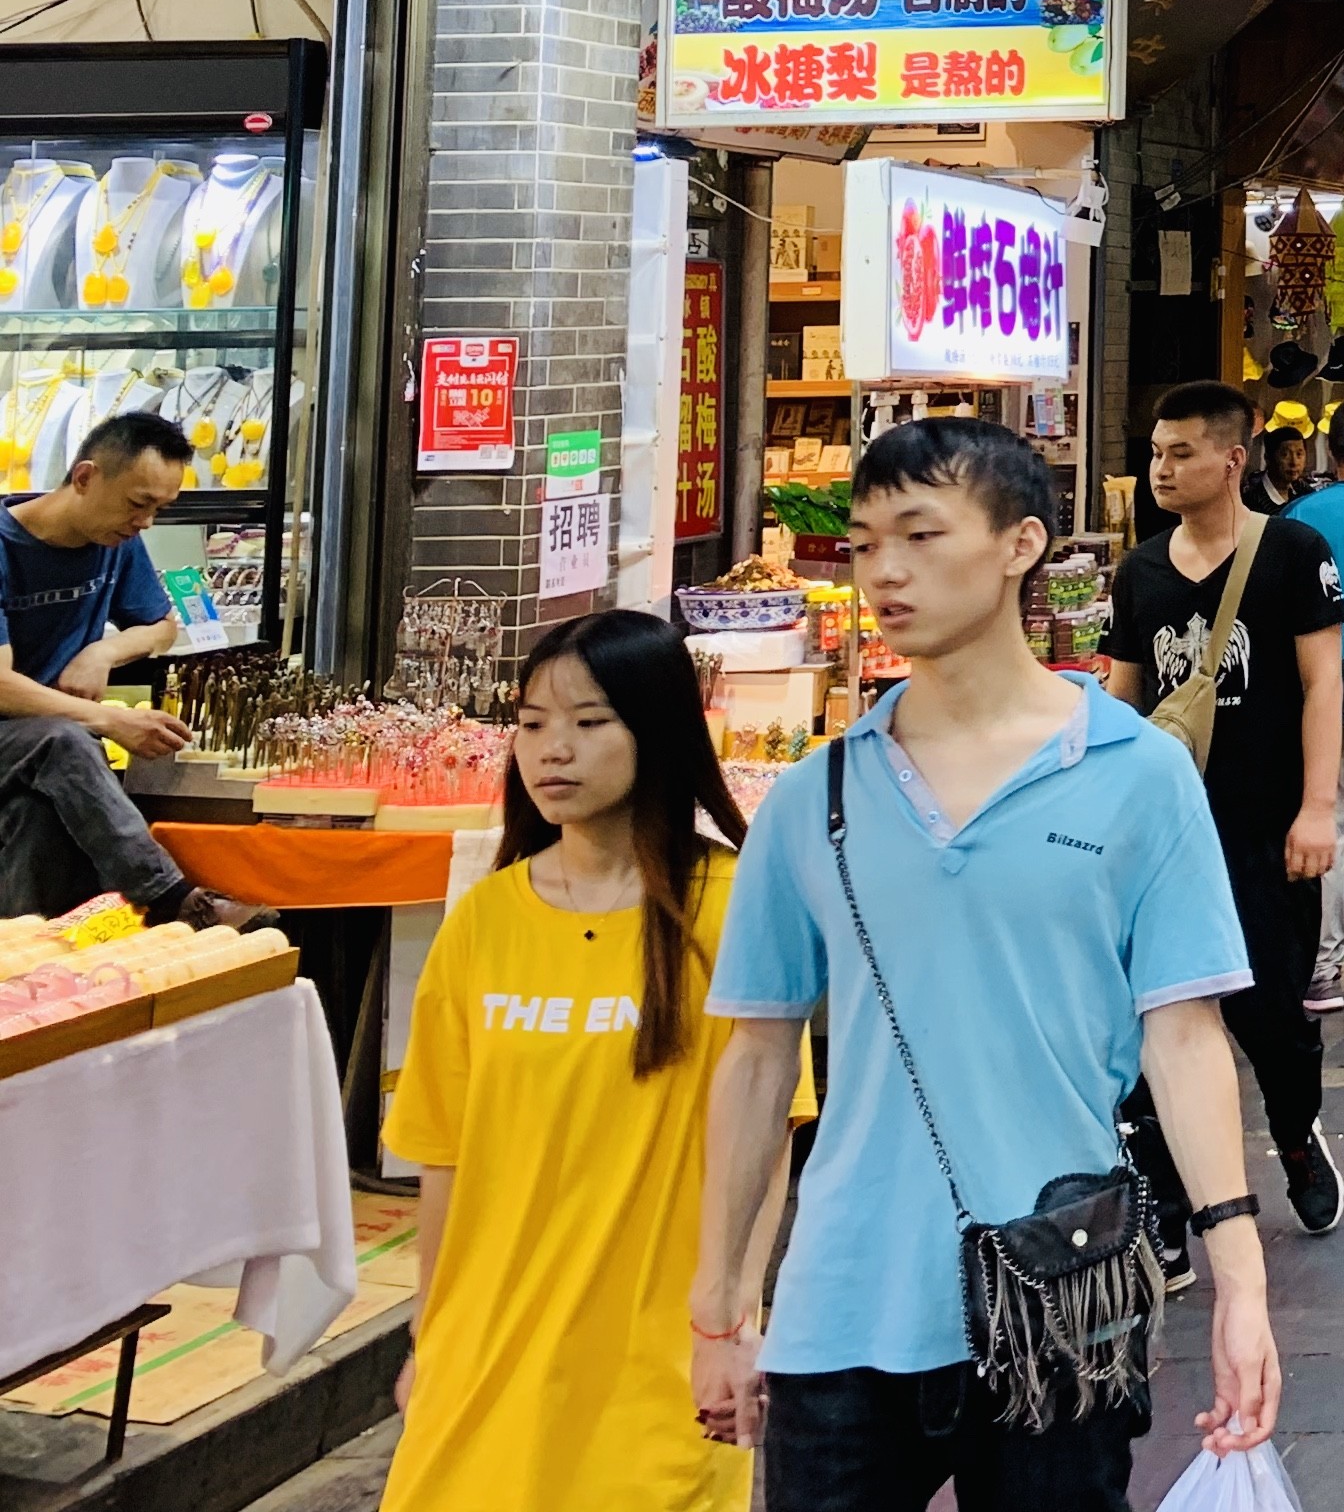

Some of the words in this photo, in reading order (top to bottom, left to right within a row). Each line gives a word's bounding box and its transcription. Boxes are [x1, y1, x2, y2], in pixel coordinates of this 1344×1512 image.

[719, 41, 879, 104] 冰糖梨
[900, 48, 1026, 99] 是熬的
[941, 202, 1064, 342] 鲜榨石榴汁
[470, 388, 494, 407] 10
[695, 325, 718, 519] 酸梅汤
[549, 500, 600, 553] 招聘
[482, 993, 573, 1033] THE
[584, 995, 642, 1032] EN
